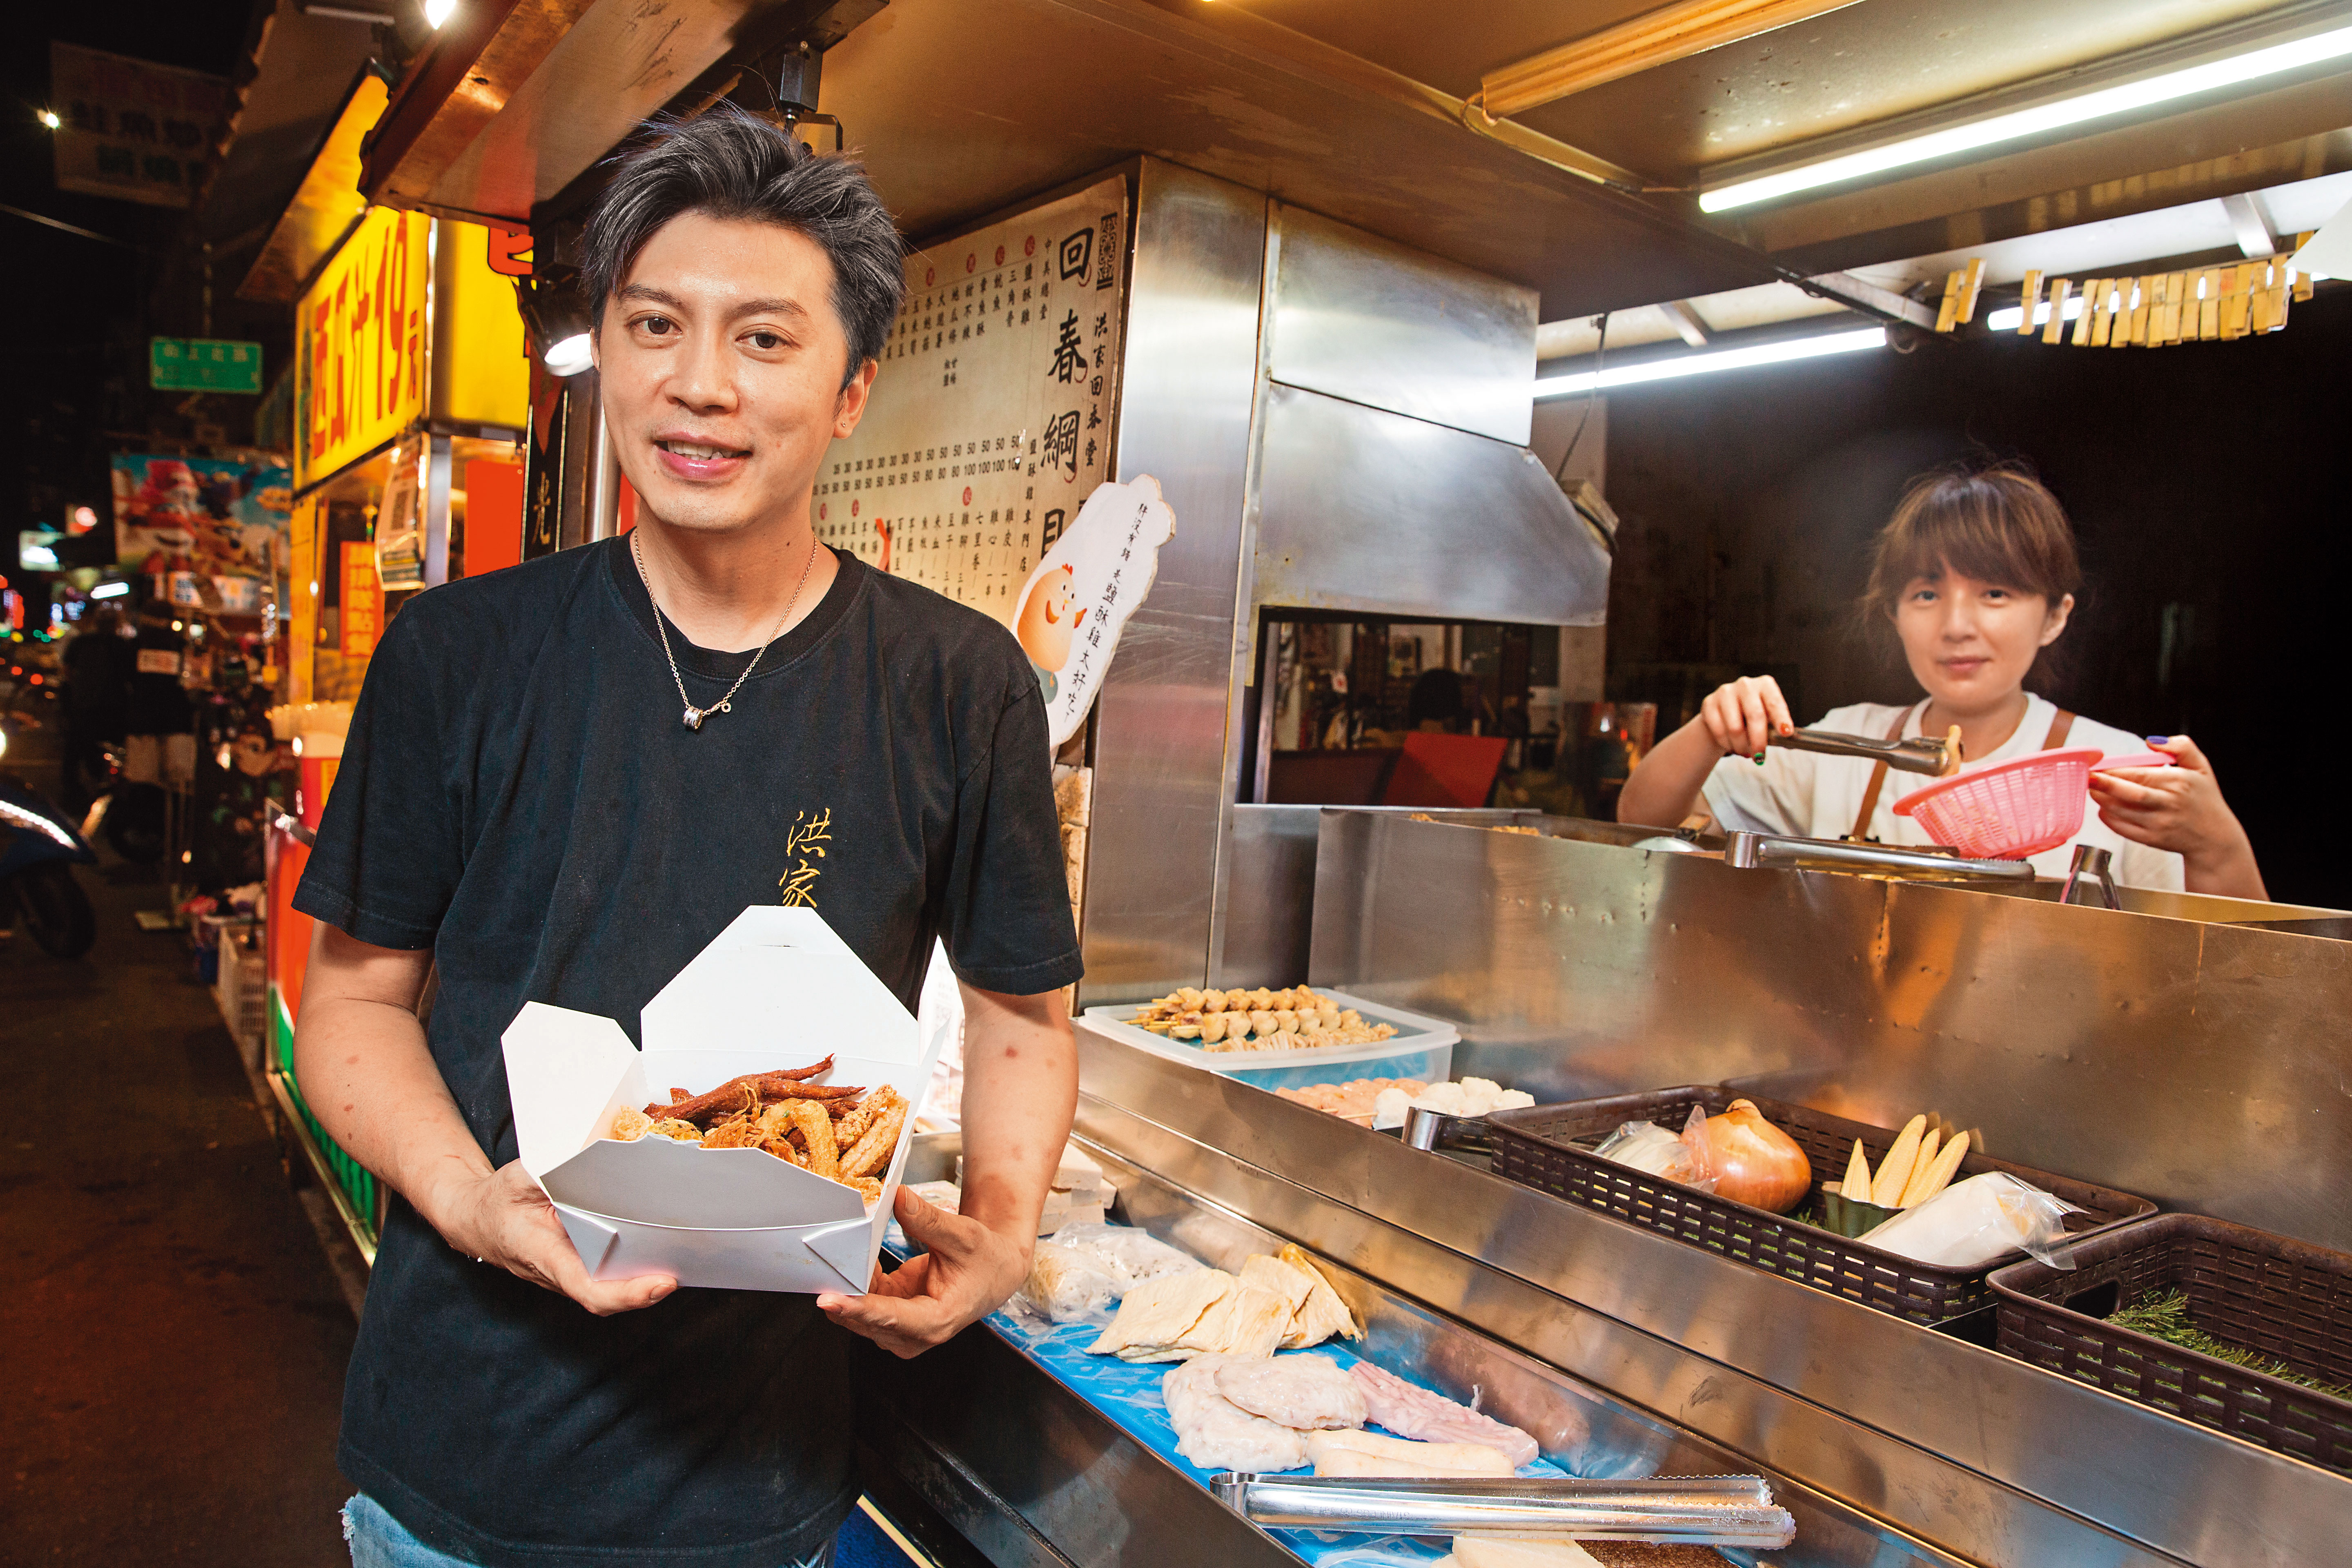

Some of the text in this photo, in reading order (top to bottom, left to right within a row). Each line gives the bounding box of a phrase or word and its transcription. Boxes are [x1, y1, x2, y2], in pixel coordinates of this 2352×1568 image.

[1041, 227, 1094, 560] 回春綱目
[940, 446, 948, 459] 50
[953, 444, 962, 457] 50
[967, 442, 976, 455] 50
[981, 439, 990, 453] 50
[996, 437, 1005, 451] 50
[1011, 434, 1020, 449] 50
[964, 463, 976, 476] 100
[978, 461, 991, 474] 100
[992, 459, 1005, 472] 100
[972, 511, 984, 570] 七里香
[778, 807, 831, 908] 洪家
